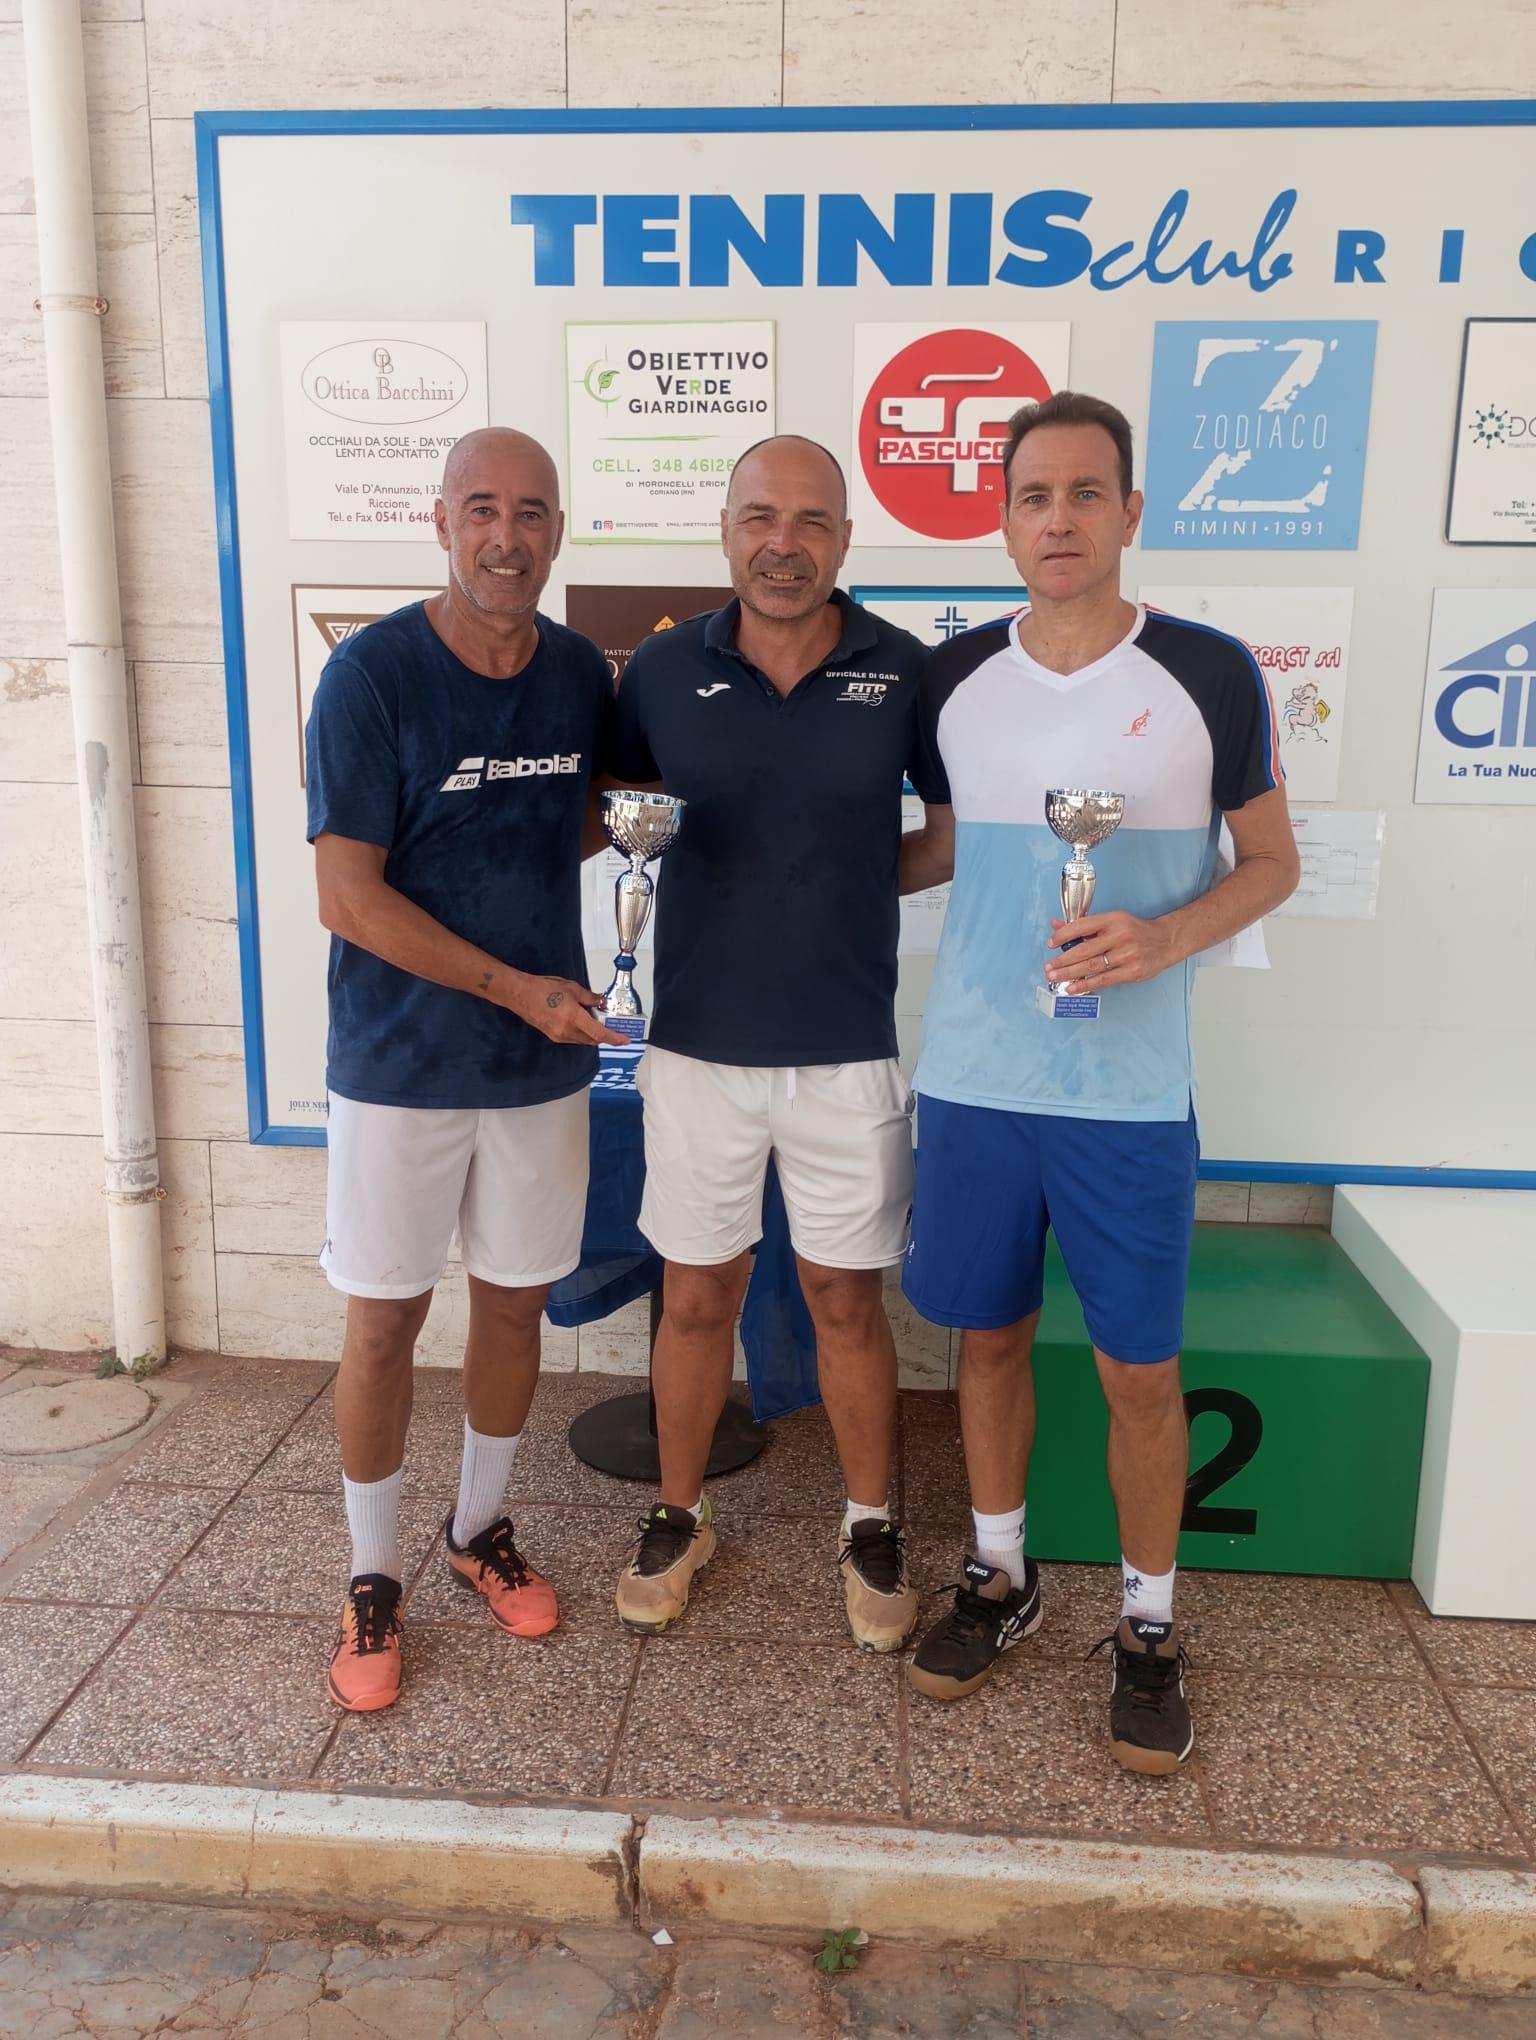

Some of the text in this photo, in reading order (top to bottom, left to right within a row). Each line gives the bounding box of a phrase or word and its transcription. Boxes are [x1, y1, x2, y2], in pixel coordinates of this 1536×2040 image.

[511, 189, 1093, 288] TENNIS
[1089, 189, 1297, 292] club
[627, 349, 769, 371] OBIETTIVO
[315, 376, 454, 401] Ottica Bacchini
[656, 375, 731, 395] VERDE
[628, 399, 768, 414] GIARDINAGGIO
[1192, 414, 1328, 449] ZODIACO
[309, 436, 362, 446] OCCHIALI
[365, 436, 381, 446] DA
[384, 437, 409, 446] SOLE
[419, 437, 435, 447] DA
[437, 437, 460, 447] VIST
[336, 449, 439, 459] LENTI A CONTATTO
[882, 441, 1004, 461] PASCUCC
[592, 459, 641, 472] CELL.
[652, 459, 683, 472] 348
[335, 484, 359, 494] Viale
[362, 484, 423, 495] D'Annunzio,
[368, 499, 411, 509] Riccione
[328, 512, 345, 522] Tel.
[346, 514, 352, 522] e
[355, 512, 372, 522] Fax
[375, 511, 403, 522] 0541
[1315, 647, 1341, 668] srl
[826, 671, 867, 679] UFFICIALE
[879, 673, 900, 681] GARA
[847, 682, 887, 694] FITP
[1448, 763, 1467, 777] La
[1473, 764, 1502, 777] Tua
[453, 776, 477, 788] PLAY
[1180, 1388, 1263, 1535] 2
